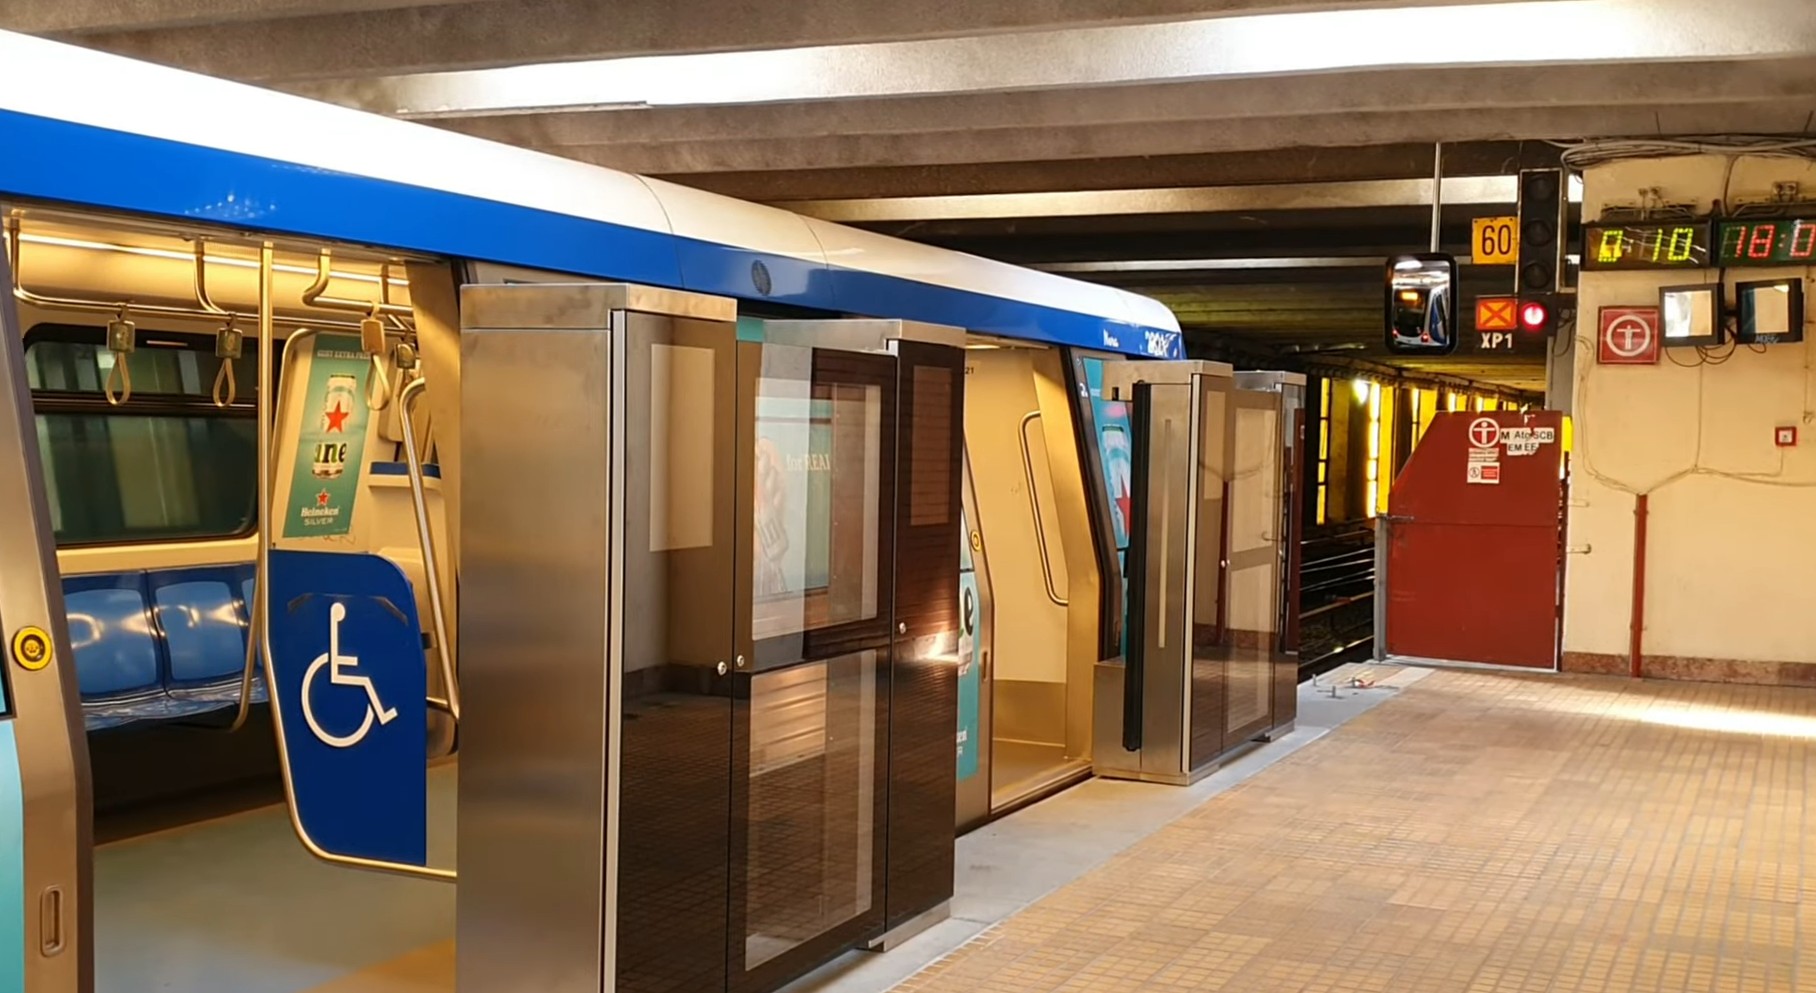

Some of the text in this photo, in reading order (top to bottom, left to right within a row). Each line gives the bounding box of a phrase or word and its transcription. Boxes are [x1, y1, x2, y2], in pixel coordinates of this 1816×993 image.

[1481, 224, 1511, 256] 60
[1652, 227, 1693, 261] 10
[1481, 332, 1513, 349] XP1
[1501, 432, 1510, 440] M
[1508, 443, 1522, 452] EM
[303, 517, 334, 526] SILVER
